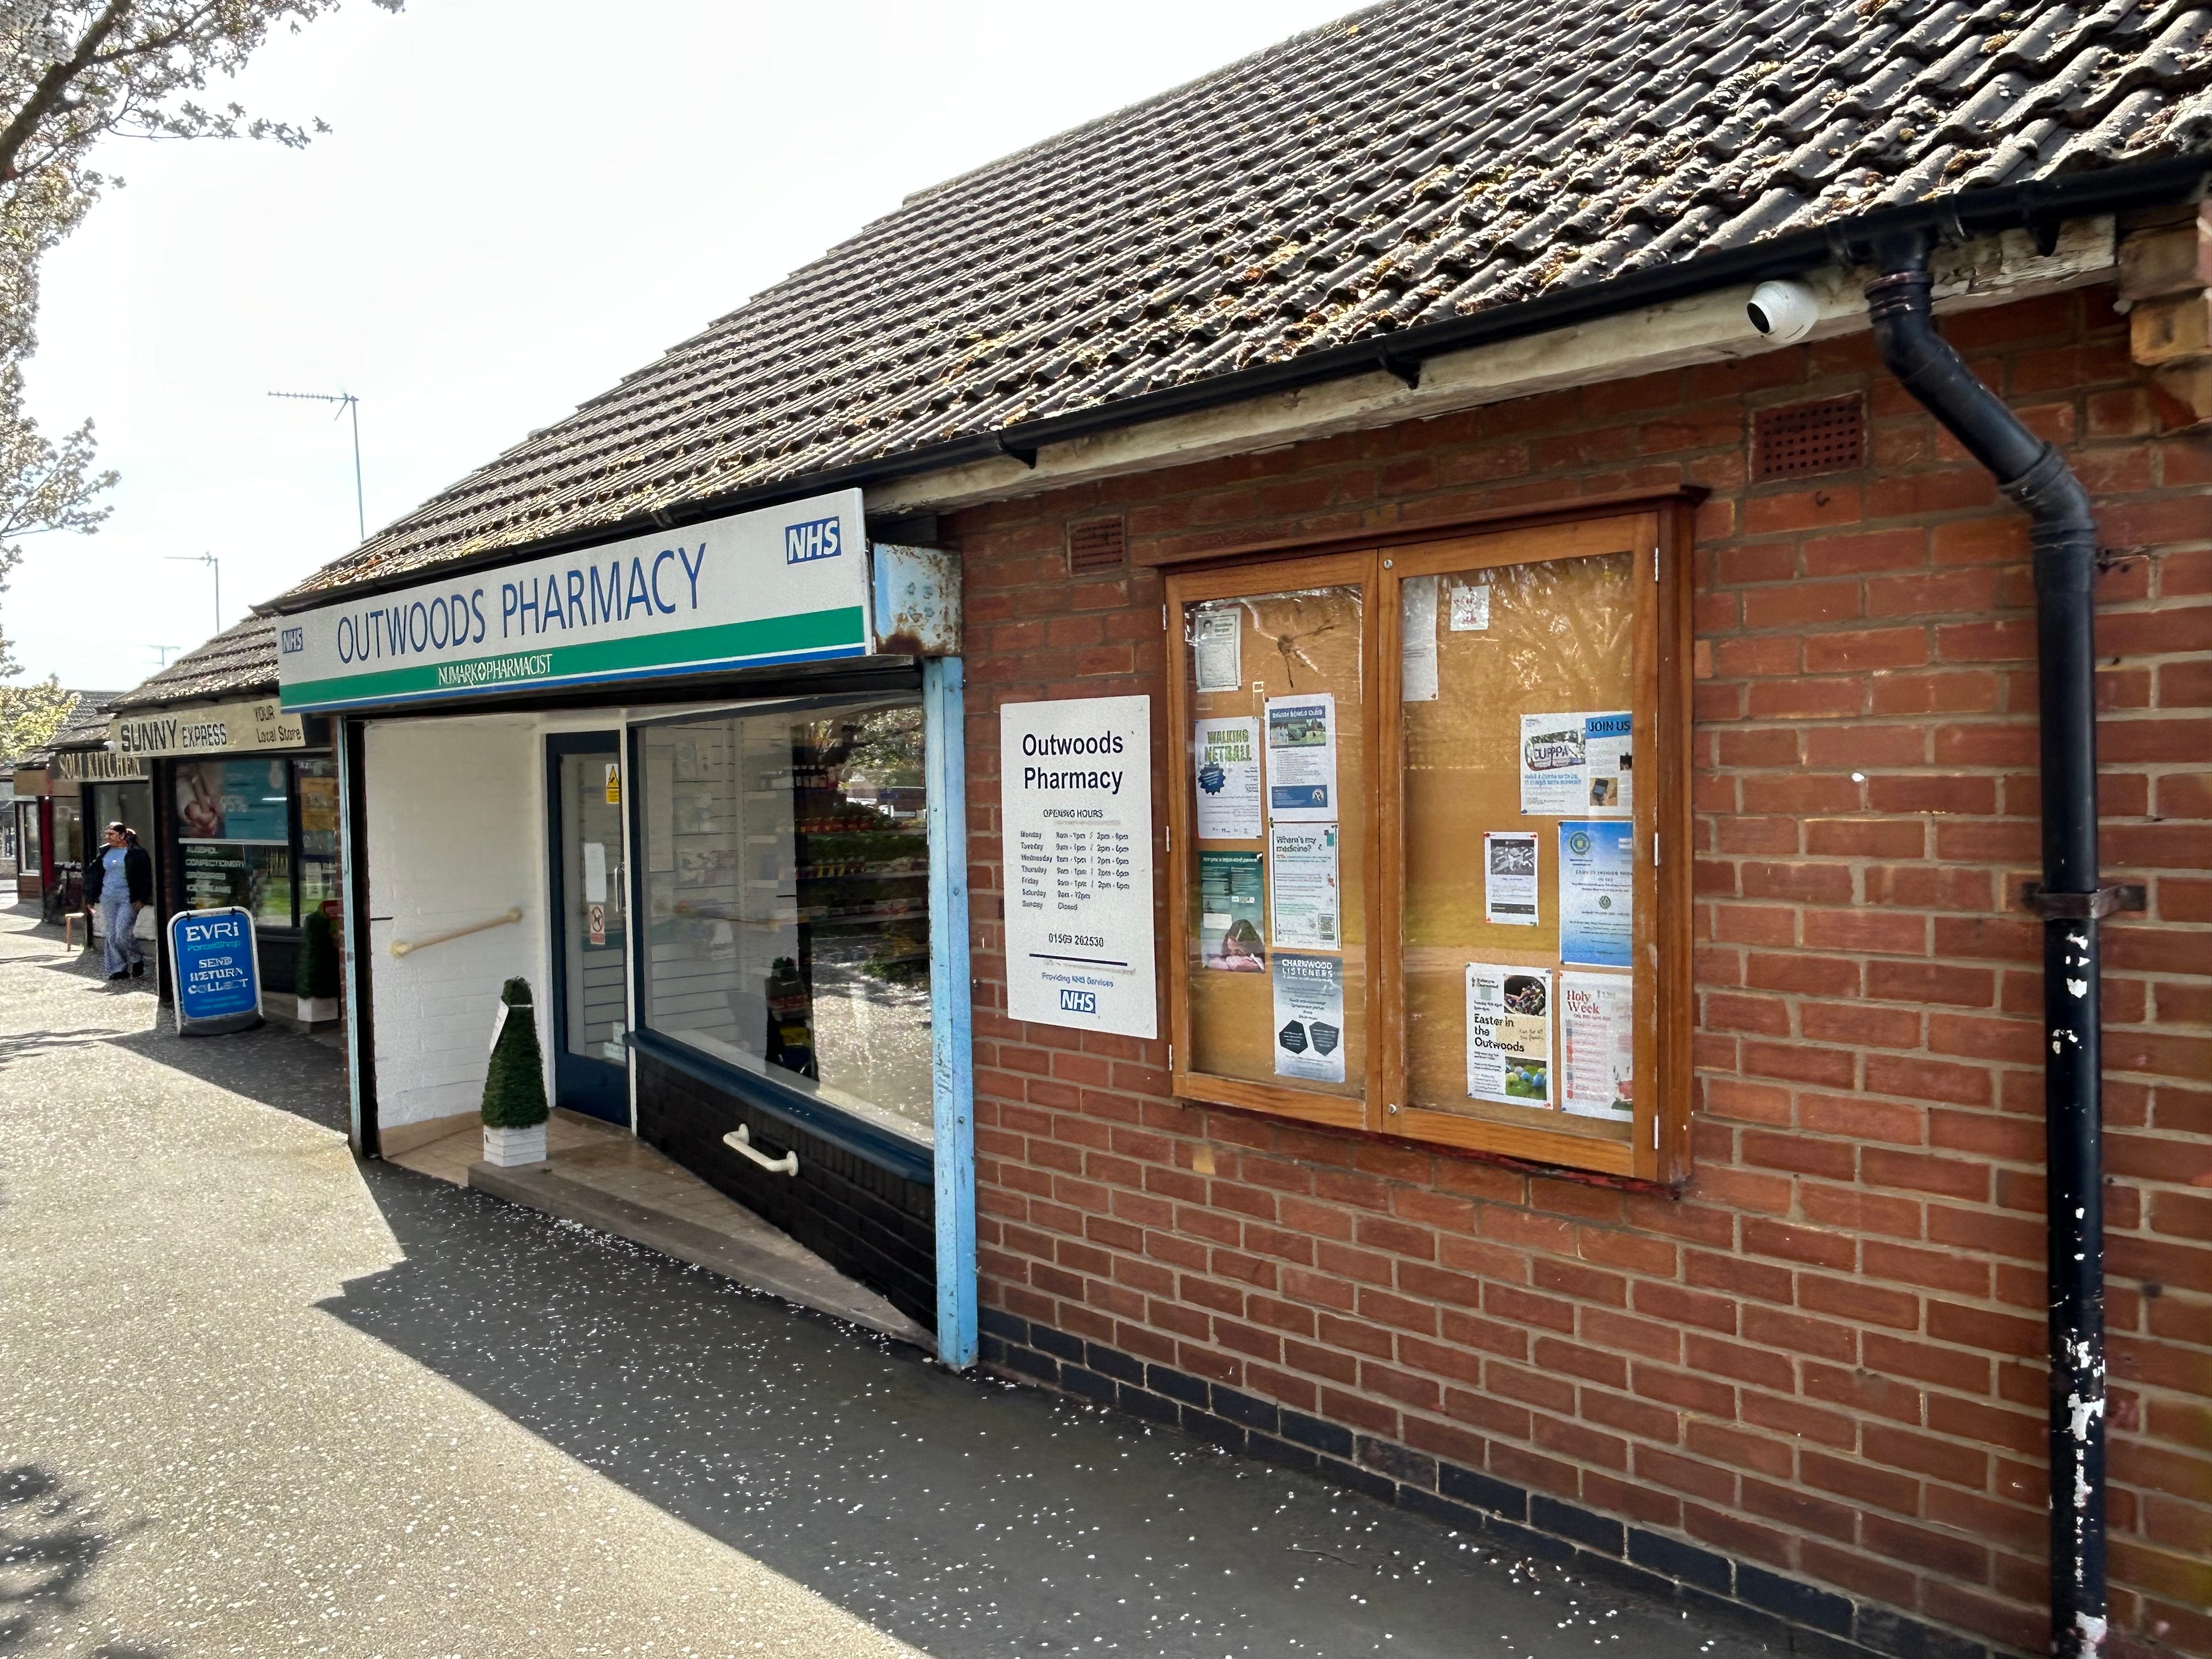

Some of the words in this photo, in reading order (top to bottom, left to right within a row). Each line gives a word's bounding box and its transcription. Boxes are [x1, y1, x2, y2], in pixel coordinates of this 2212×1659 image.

[787, 519, 839, 562] NHS
[338, 589, 486, 664] OUTWOODS
[503, 542, 706, 638] PHARMACY
[281, 628, 303, 653] NHS
[253, 706, 275, 722] YOUR
[1588, 720, 1613, 732] JOIN
[1616, 720, 1631, 731] US
[121, 719, 177, 752] SUNNY
[182, 723, 227, 748] EXPRESS
[256, 728, 276, 743] Local
[278, 725, 302, 741] Store
[1207, 729, 1249, 744] WALKING
[1022, 730, 1124, 757] Outwoods
[1204, 744, 1252, 763] NETBALL
[1024, 767, 1123, 795] Pharmacy
[1076, 809, 1103, 818] HOURS
[1097, 832, 1110, 841] 2pm
[1097, 844, 1110, 853] 2pm
[1097, 856, 1110, 865] 2pm
[1098, 868, 1111, 878] 2pm
[1022, 877, 1039, 886] Friday
[1098, 881, 1111, 889] 2pm
[198, 956, 233, 968] SEND
[1282, 959, 1333, 970] CHARNWOOD
[190, 967, 243, 982] RETURN
[1282, 968, 1333, 978] LISTENERS
[188, 978, 249, 995] COLLECT
[1062, 990, 1094, 1012] NHS
[1567, 989, 1590, 1004] Holy
[1567, 1001, 1600, 1014] Week
[1474, 1013, 1503, 1026] Easter
[1474, 1025, 1490, 1036] the
[1474, 1037, 1525, 1052] Outwoods
